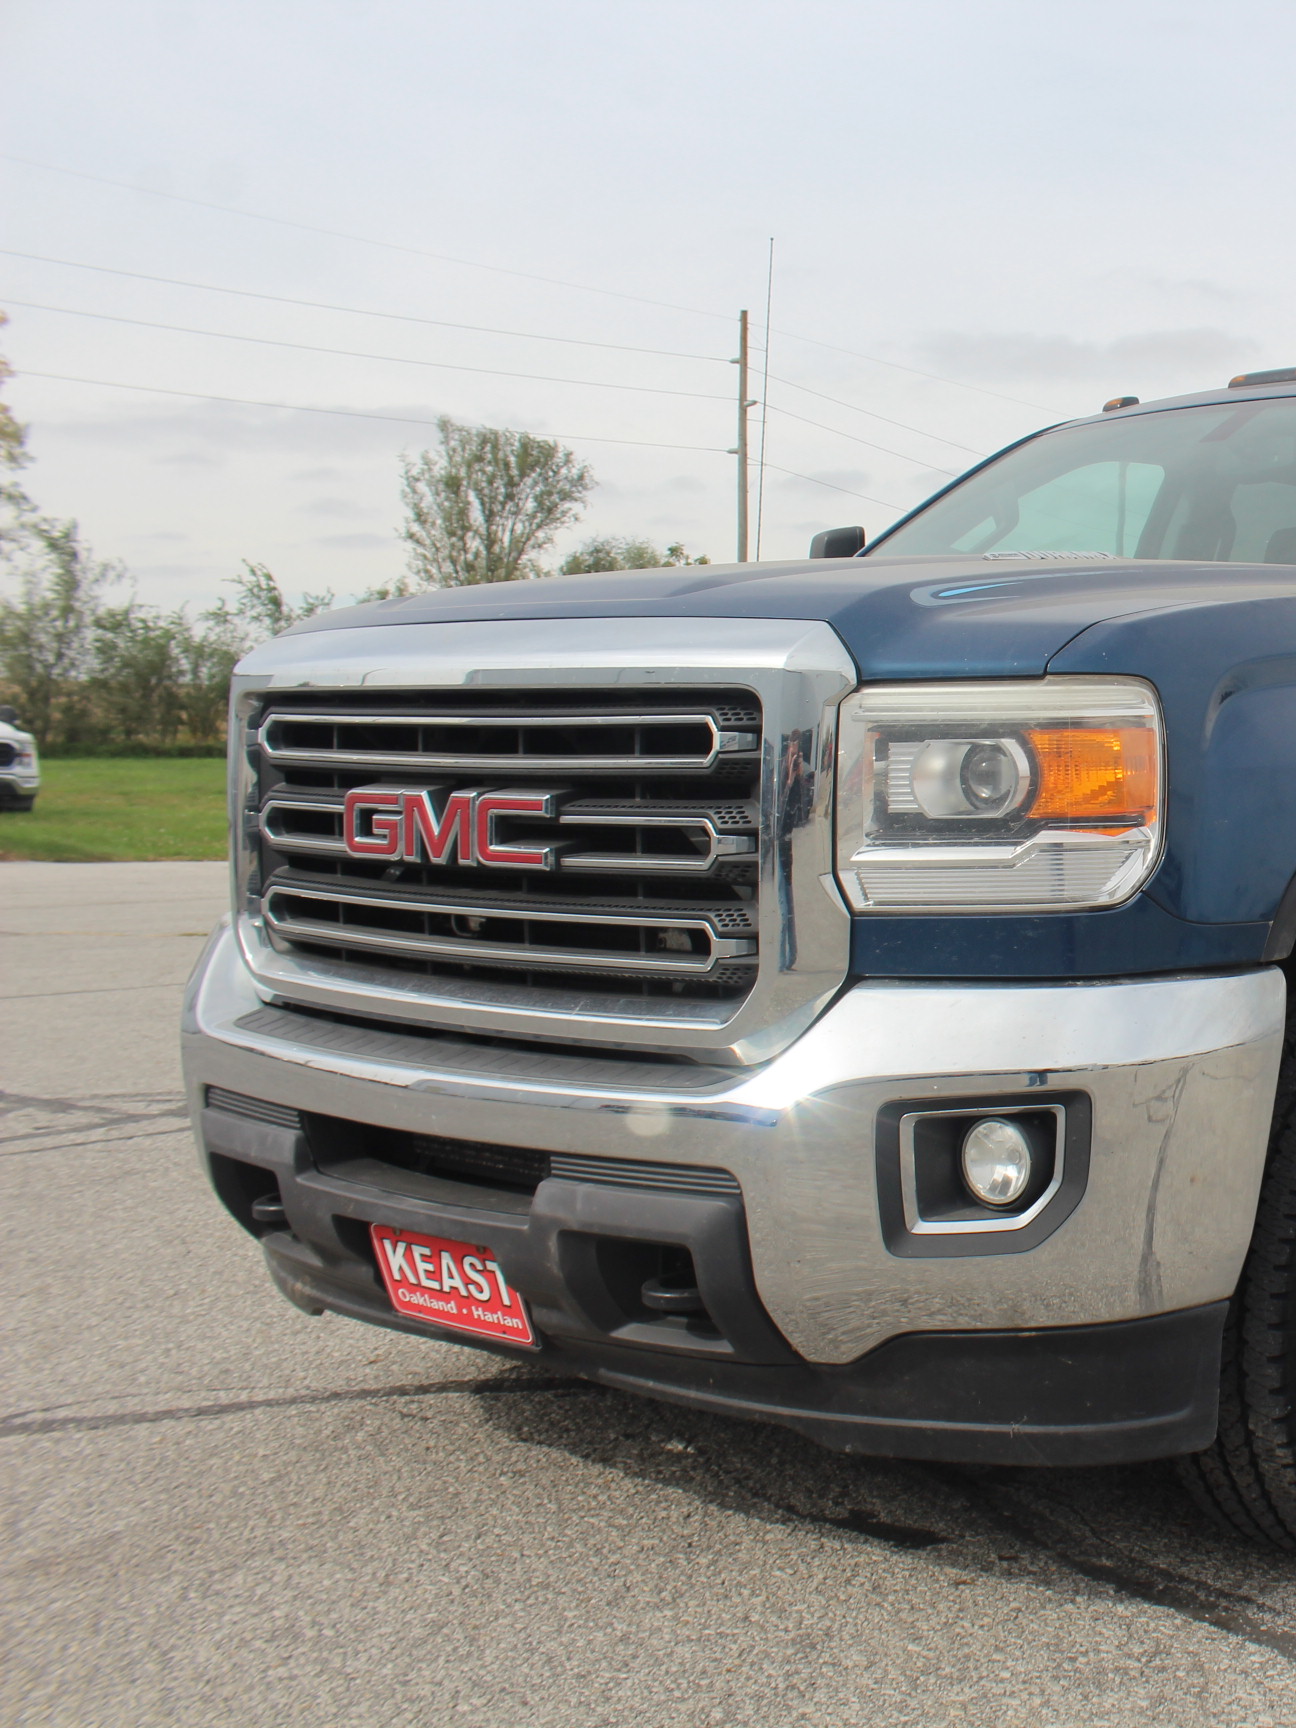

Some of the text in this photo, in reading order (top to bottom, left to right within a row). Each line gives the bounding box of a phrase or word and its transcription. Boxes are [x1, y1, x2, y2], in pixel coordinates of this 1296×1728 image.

[344, 788, 552, 871] GMC
[382, 1238, 512, 1307] KEAST
[398, 1288, 523, 1329] Oakland Harlan
